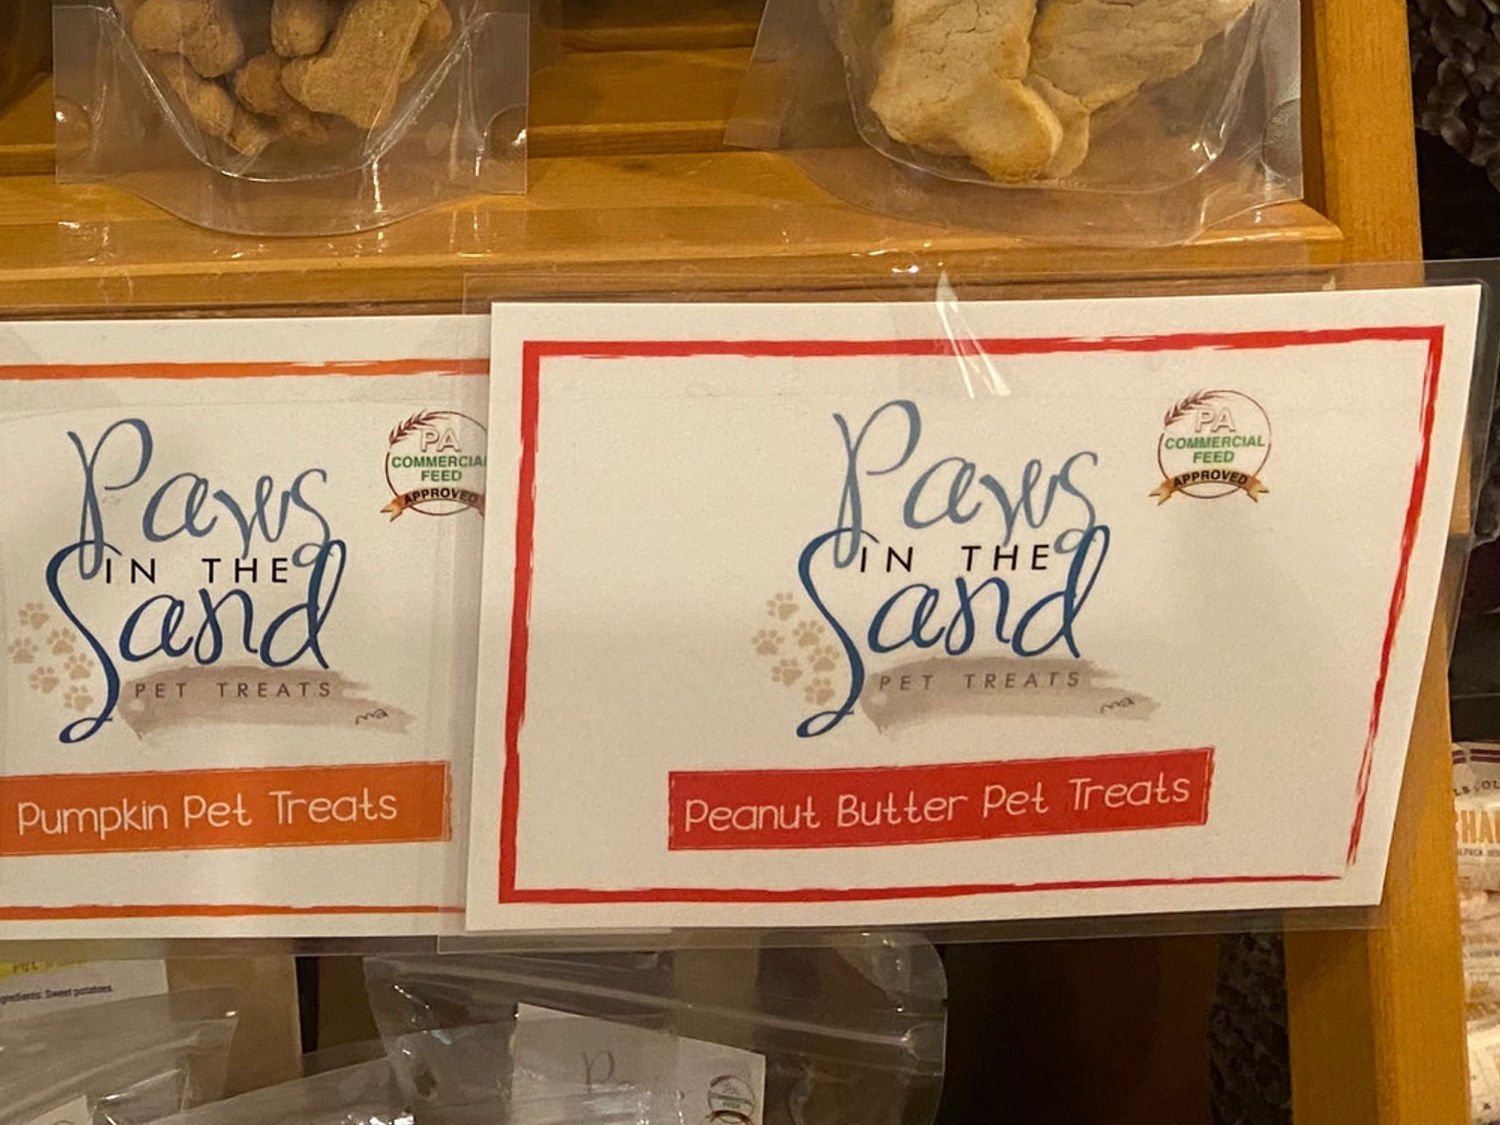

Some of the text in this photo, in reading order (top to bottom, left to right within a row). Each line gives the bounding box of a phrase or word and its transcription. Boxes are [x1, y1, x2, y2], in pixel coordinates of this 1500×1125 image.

[1195, 405, 1236, 433] PA
[420, 427, 461, 452] PA
[1164, 434, 1265, 451] COMMERCIAL
[1192, 449, 1235, 465] FEED
[420, 470, 462, 482] FEED
[831, 399, 1100, 567] Paws
[1172, 469, 1248, 489] APPROVED
[67, 418, 332, 580] Paws
[404, 488, 479, 504] APPROVED
[105, 557, 289, 584] IN THE
[860, 544, 1050, 573] IN THE
[46, 539, 347, 743] Sand
[796, 525, 1110, 738] Sand
[134, 681, 332, 698] PET TREATS
[879, 670, 1080, 692] PET TREATS
[16, 787, 397, 839] Pumpkin Pet Treats
[684, 775, 1191, 836] Peanut Butter Pet Treats
